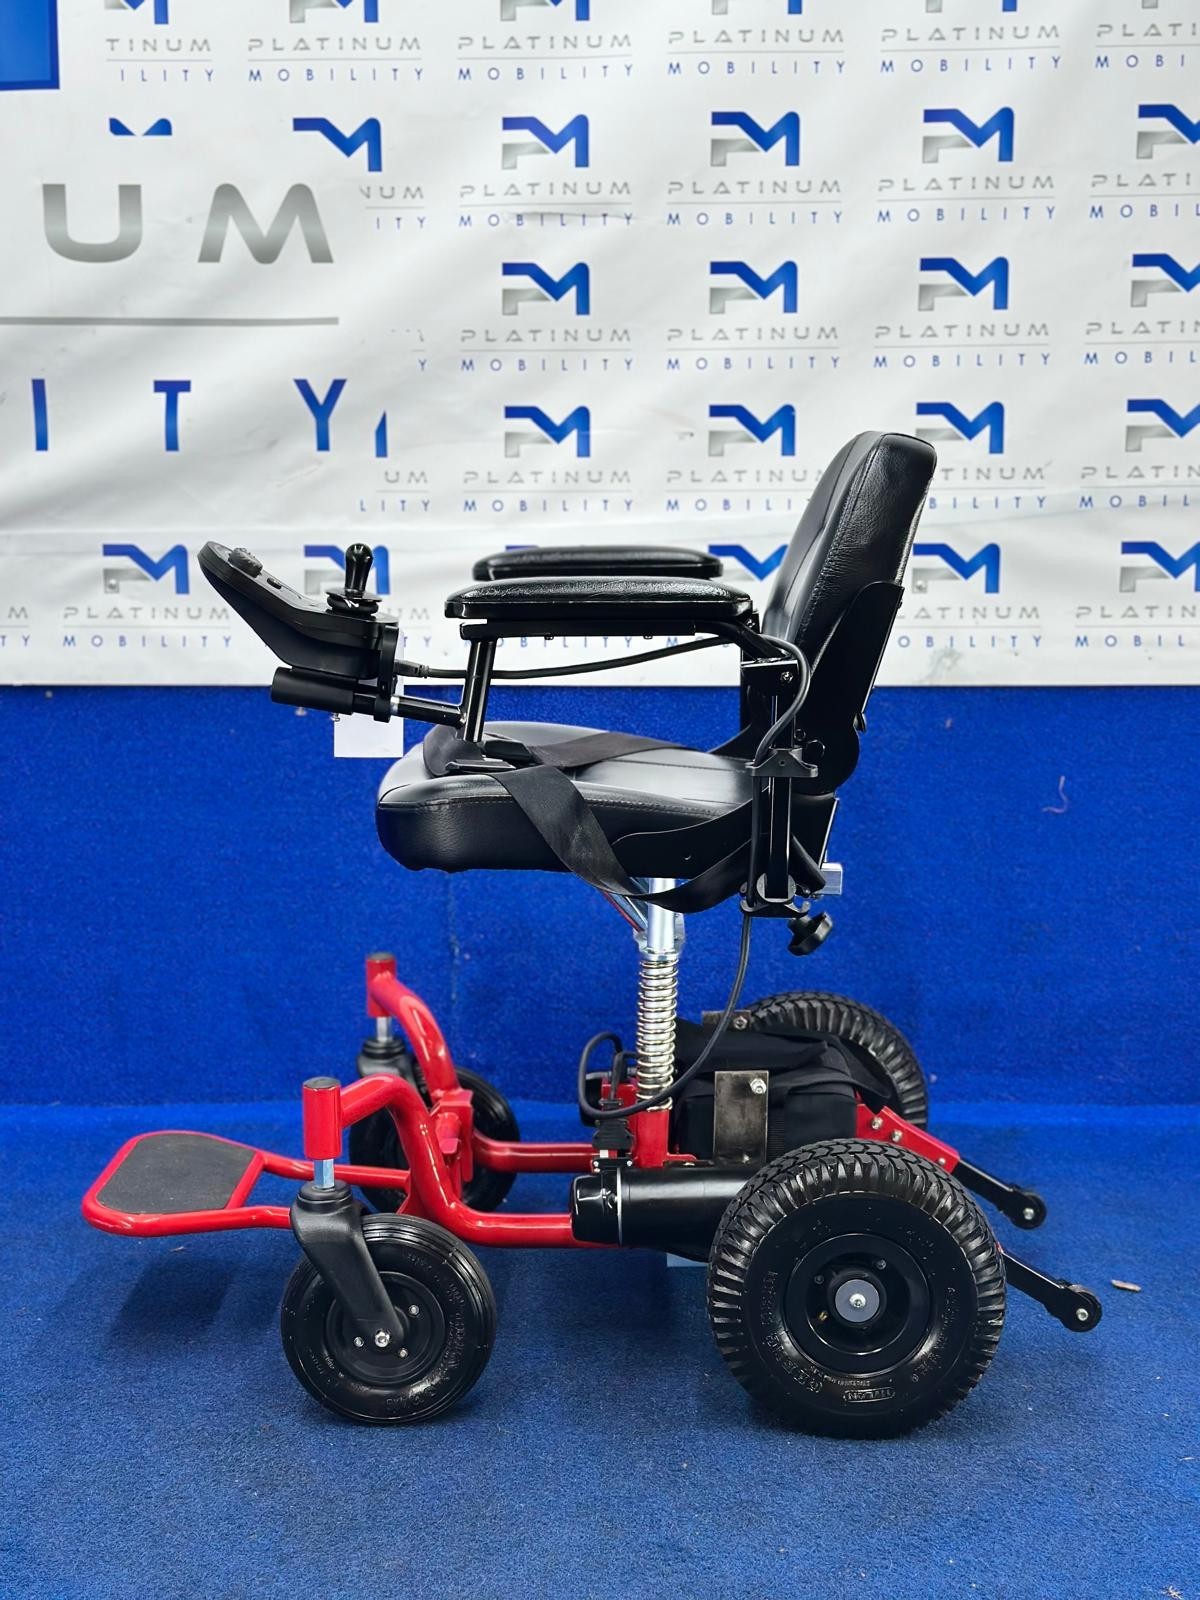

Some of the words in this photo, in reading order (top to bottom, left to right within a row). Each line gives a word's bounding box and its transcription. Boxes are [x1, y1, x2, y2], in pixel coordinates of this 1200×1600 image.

[668, 29, 844, 44] PLATINUM
[881, 25, 1059, 42] PLATINUM
[106, 38, 211, 52] TINUM
[248, 37, 420, 52] PLATINUM
[458, 34, 631, 50] PLATINUM
[458, 64, 633, 80] MOBILITY
[667, 60, 845, 75] MOBILITY
[880, 56, 1061, 73] MOBILITY
[121, 69, 213, 82] ILITY
[248, 68, 423, 82] MOBILITY
[460, 181, 631, 198] PLATINUM
[668, 180, 841, 195] PLATINUM
[878, 176, 1054, 192] PLATINUM
[458, 212, 635, 228] MOBILITY
[667, 211, 842, 226] MOBILITY
[877, 206, 1055, 223] MOBILITY
[461, 329, 631, 342] PLATINUM
[667, 326, 838, 341] PLATINUM
[875, 323, 1049, 339] PLATINUM
[460, 358, 632, 371] MOBILITY
[666, 356, 840, 370] MOBILITY
[873, 353, 1050, 368] MOBILITY
[1084, 350, 1196, 365] MOBIL
[464, 470, 630, 484] PLATINUM
[464, 499, 633, 512] MOBILITY
[64, 606, 230, 620] PLATINUM
[63, 634, 231, 648] MOBILITY
[1075, 635, 1186, 648] MOBIL
